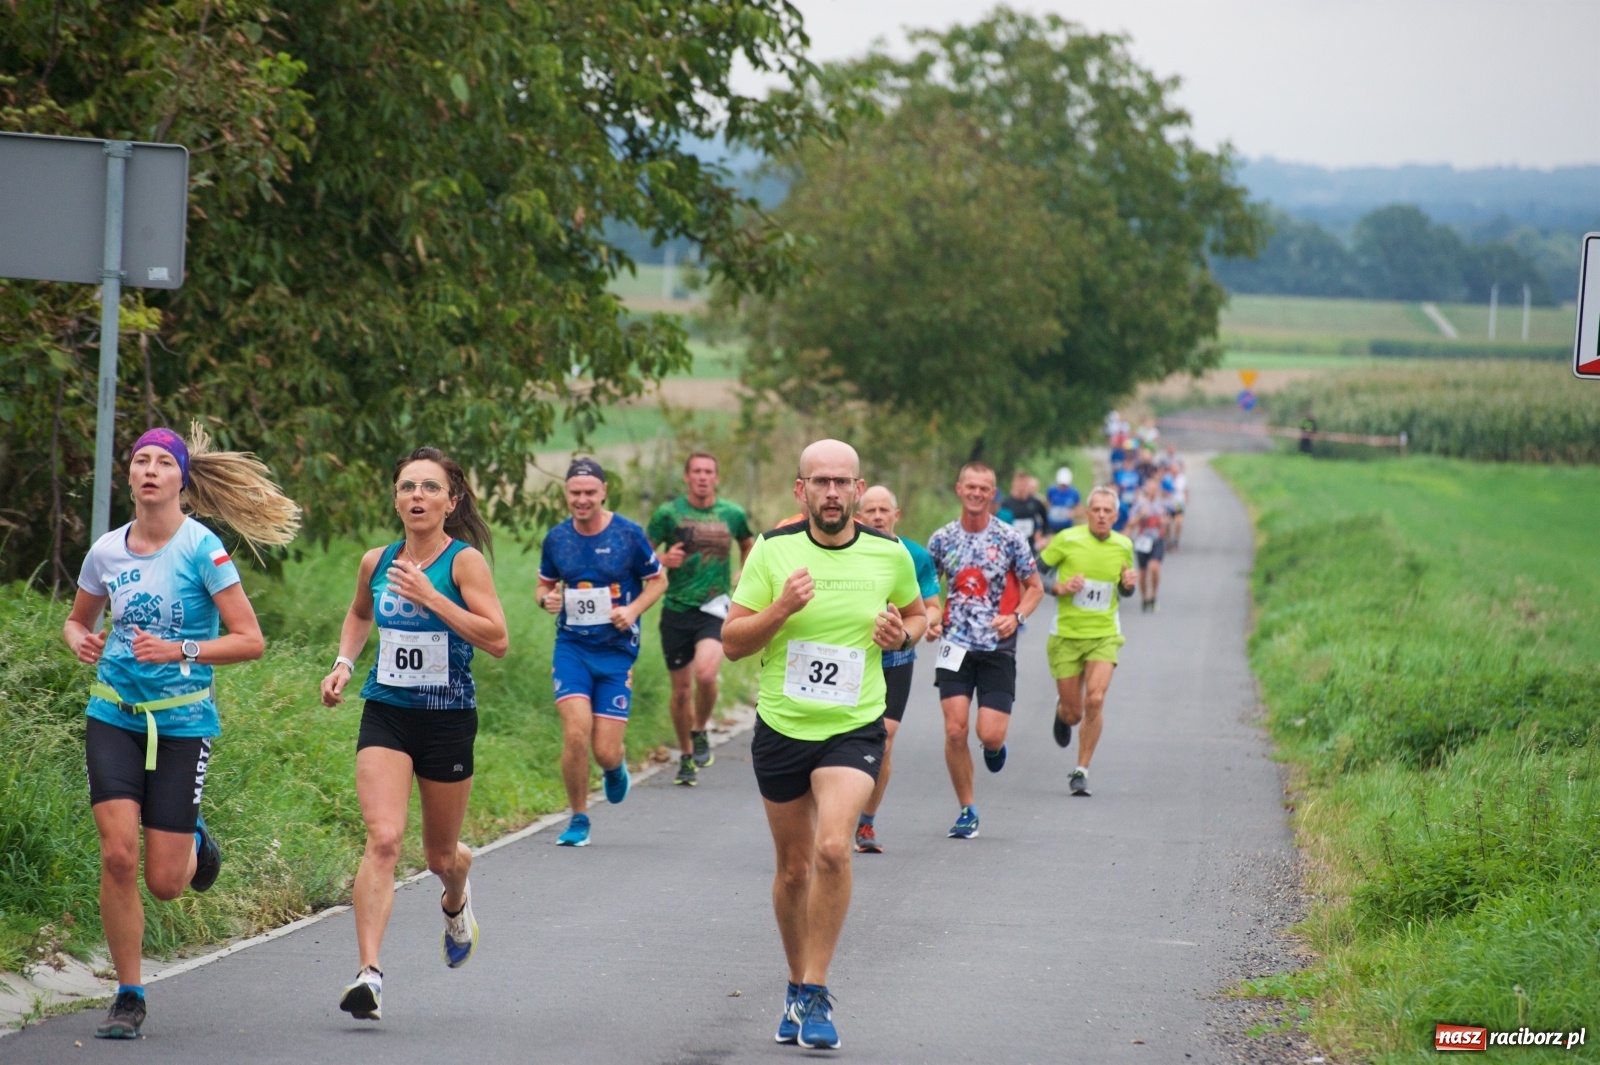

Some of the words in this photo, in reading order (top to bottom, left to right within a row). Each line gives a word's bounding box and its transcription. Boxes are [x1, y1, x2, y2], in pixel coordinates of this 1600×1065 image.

[108, 569, 141, 593] BIEG
[815, 580, 874, 591] RUNNING
[577, 600, 596, 614] 39
[1087, 590, 1101, 602] 41
[395, 647, 423, 671] 60
[808, 660, 839, 686] 32
[192, 736, 212, 804] MARTA
